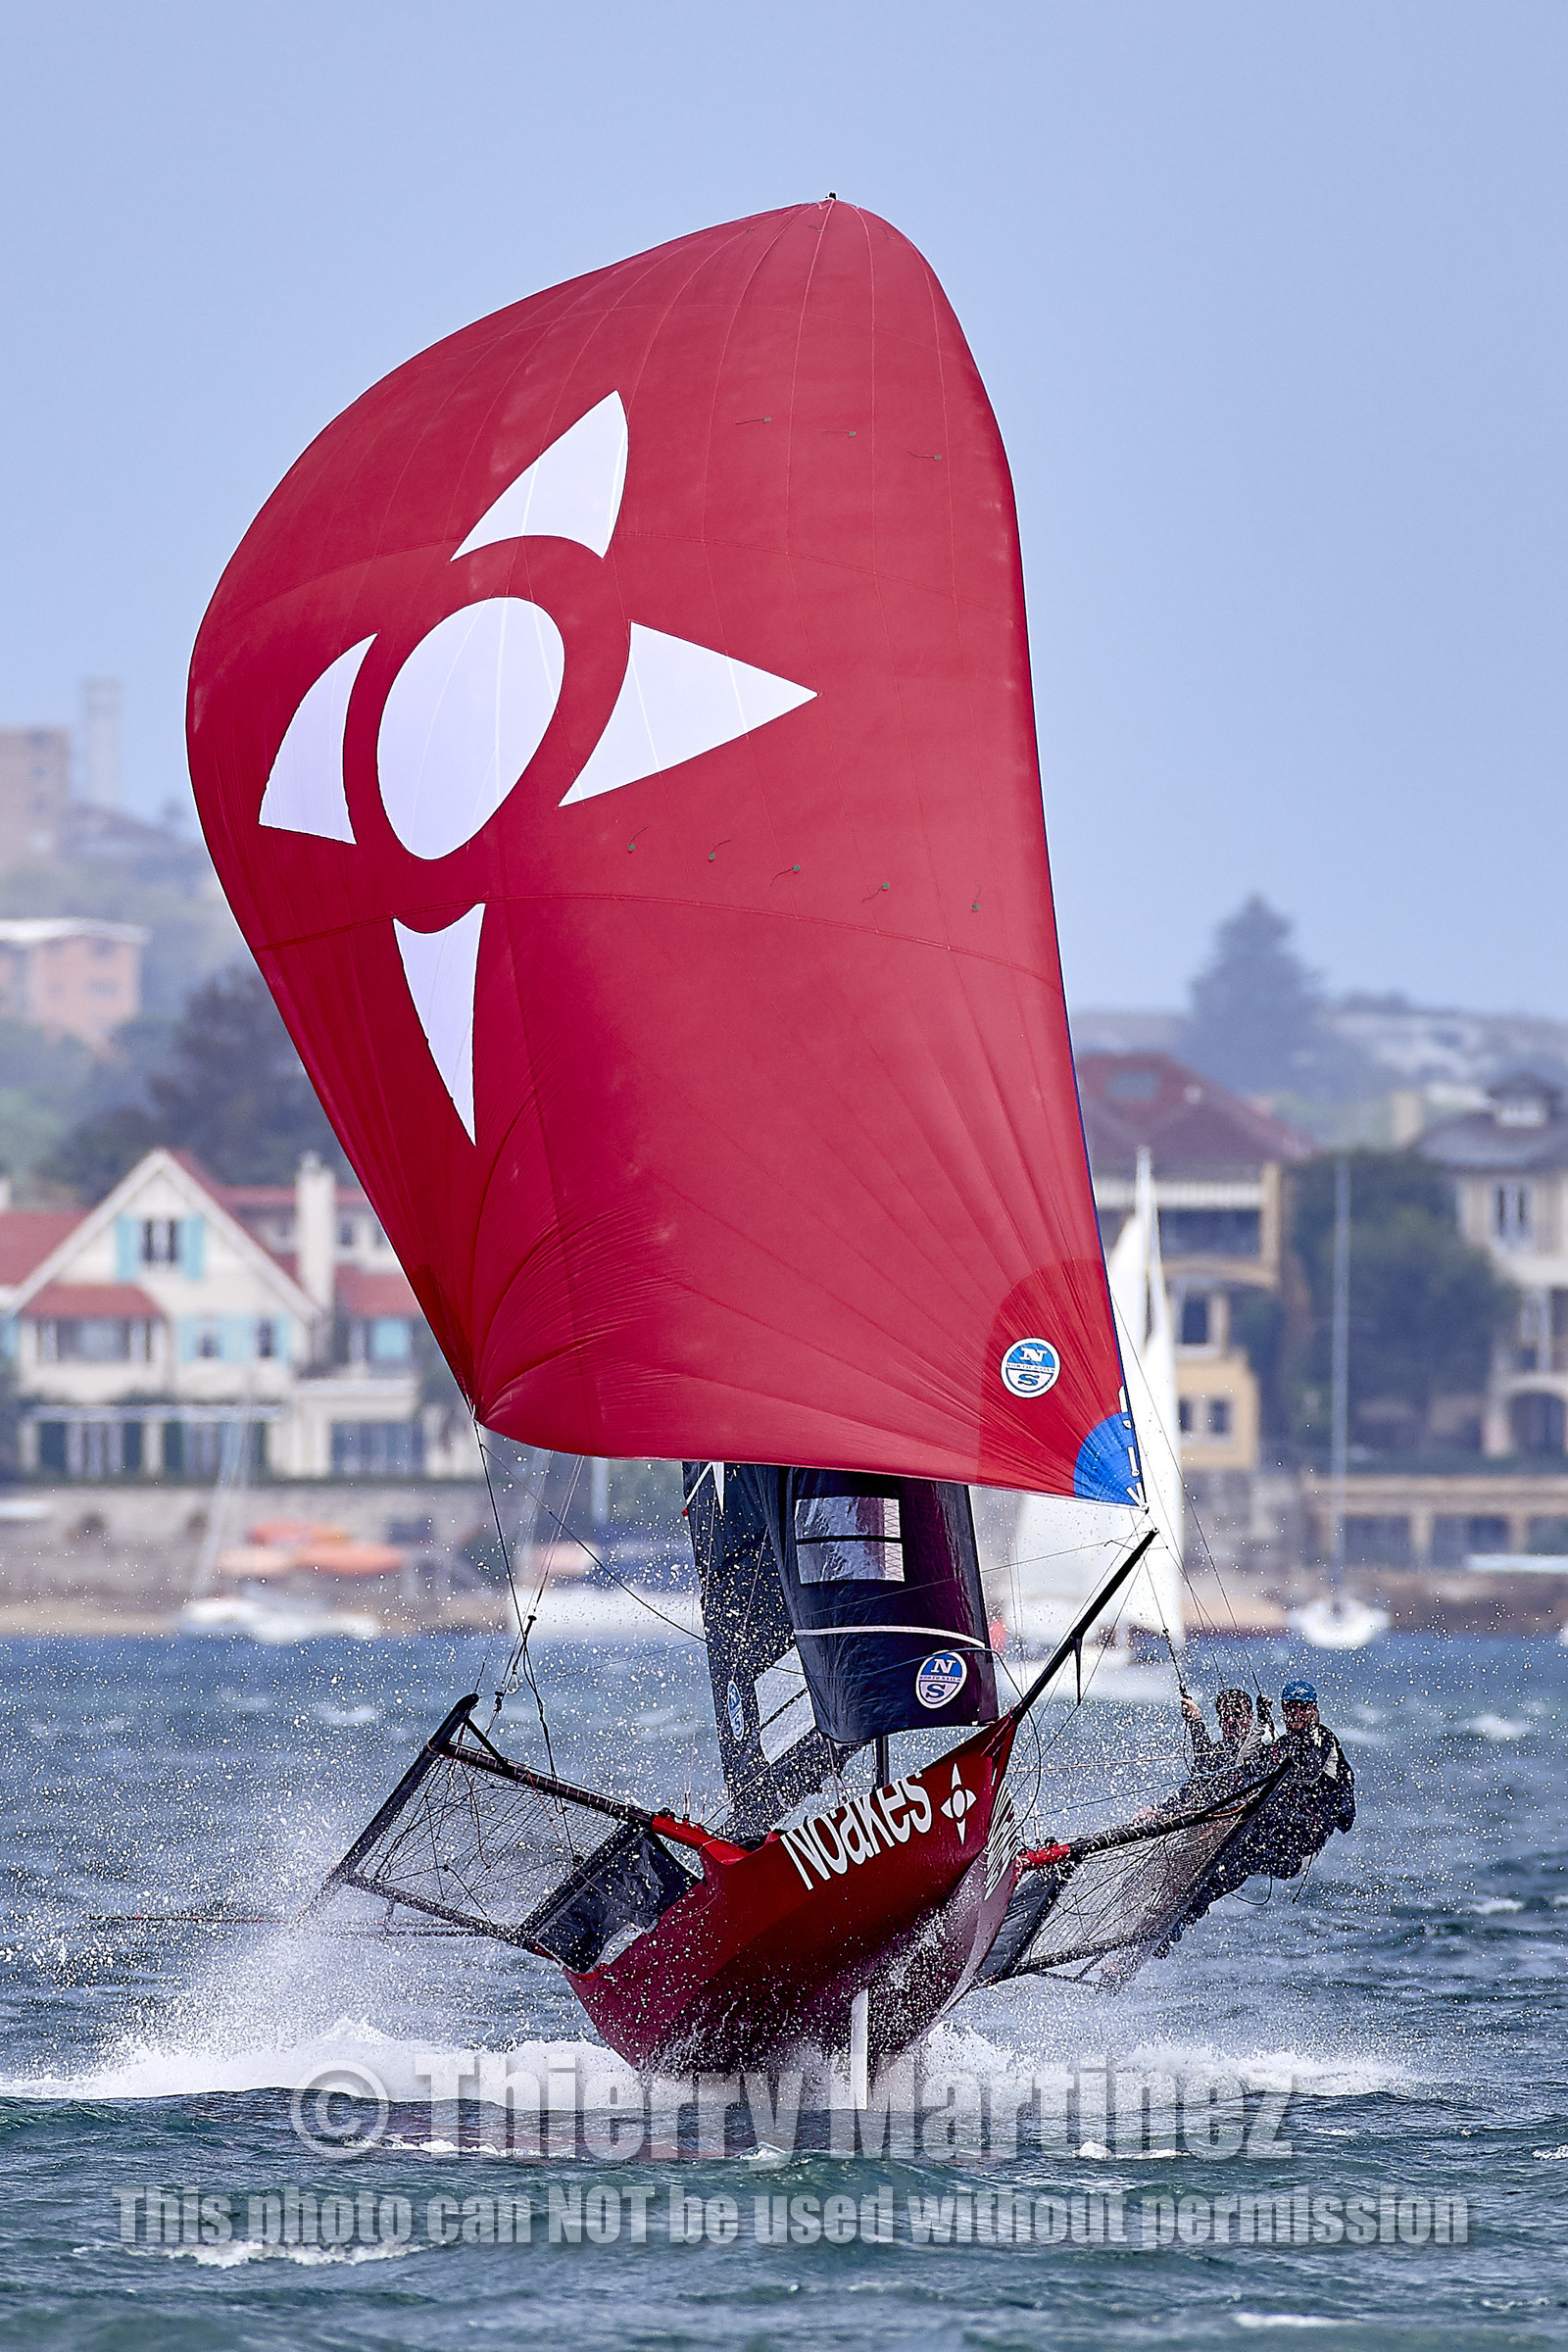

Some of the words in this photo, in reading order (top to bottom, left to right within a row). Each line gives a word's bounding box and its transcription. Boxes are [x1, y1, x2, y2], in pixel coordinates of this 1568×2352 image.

[1019, 1347, 1048, 1362] N
[1017, 1373, 1041, 1387] S
[930, 1658, 957, 1674] N
[925, 1683, 947, 1698] S
[779, 1771, 933, 1891] Noakes
